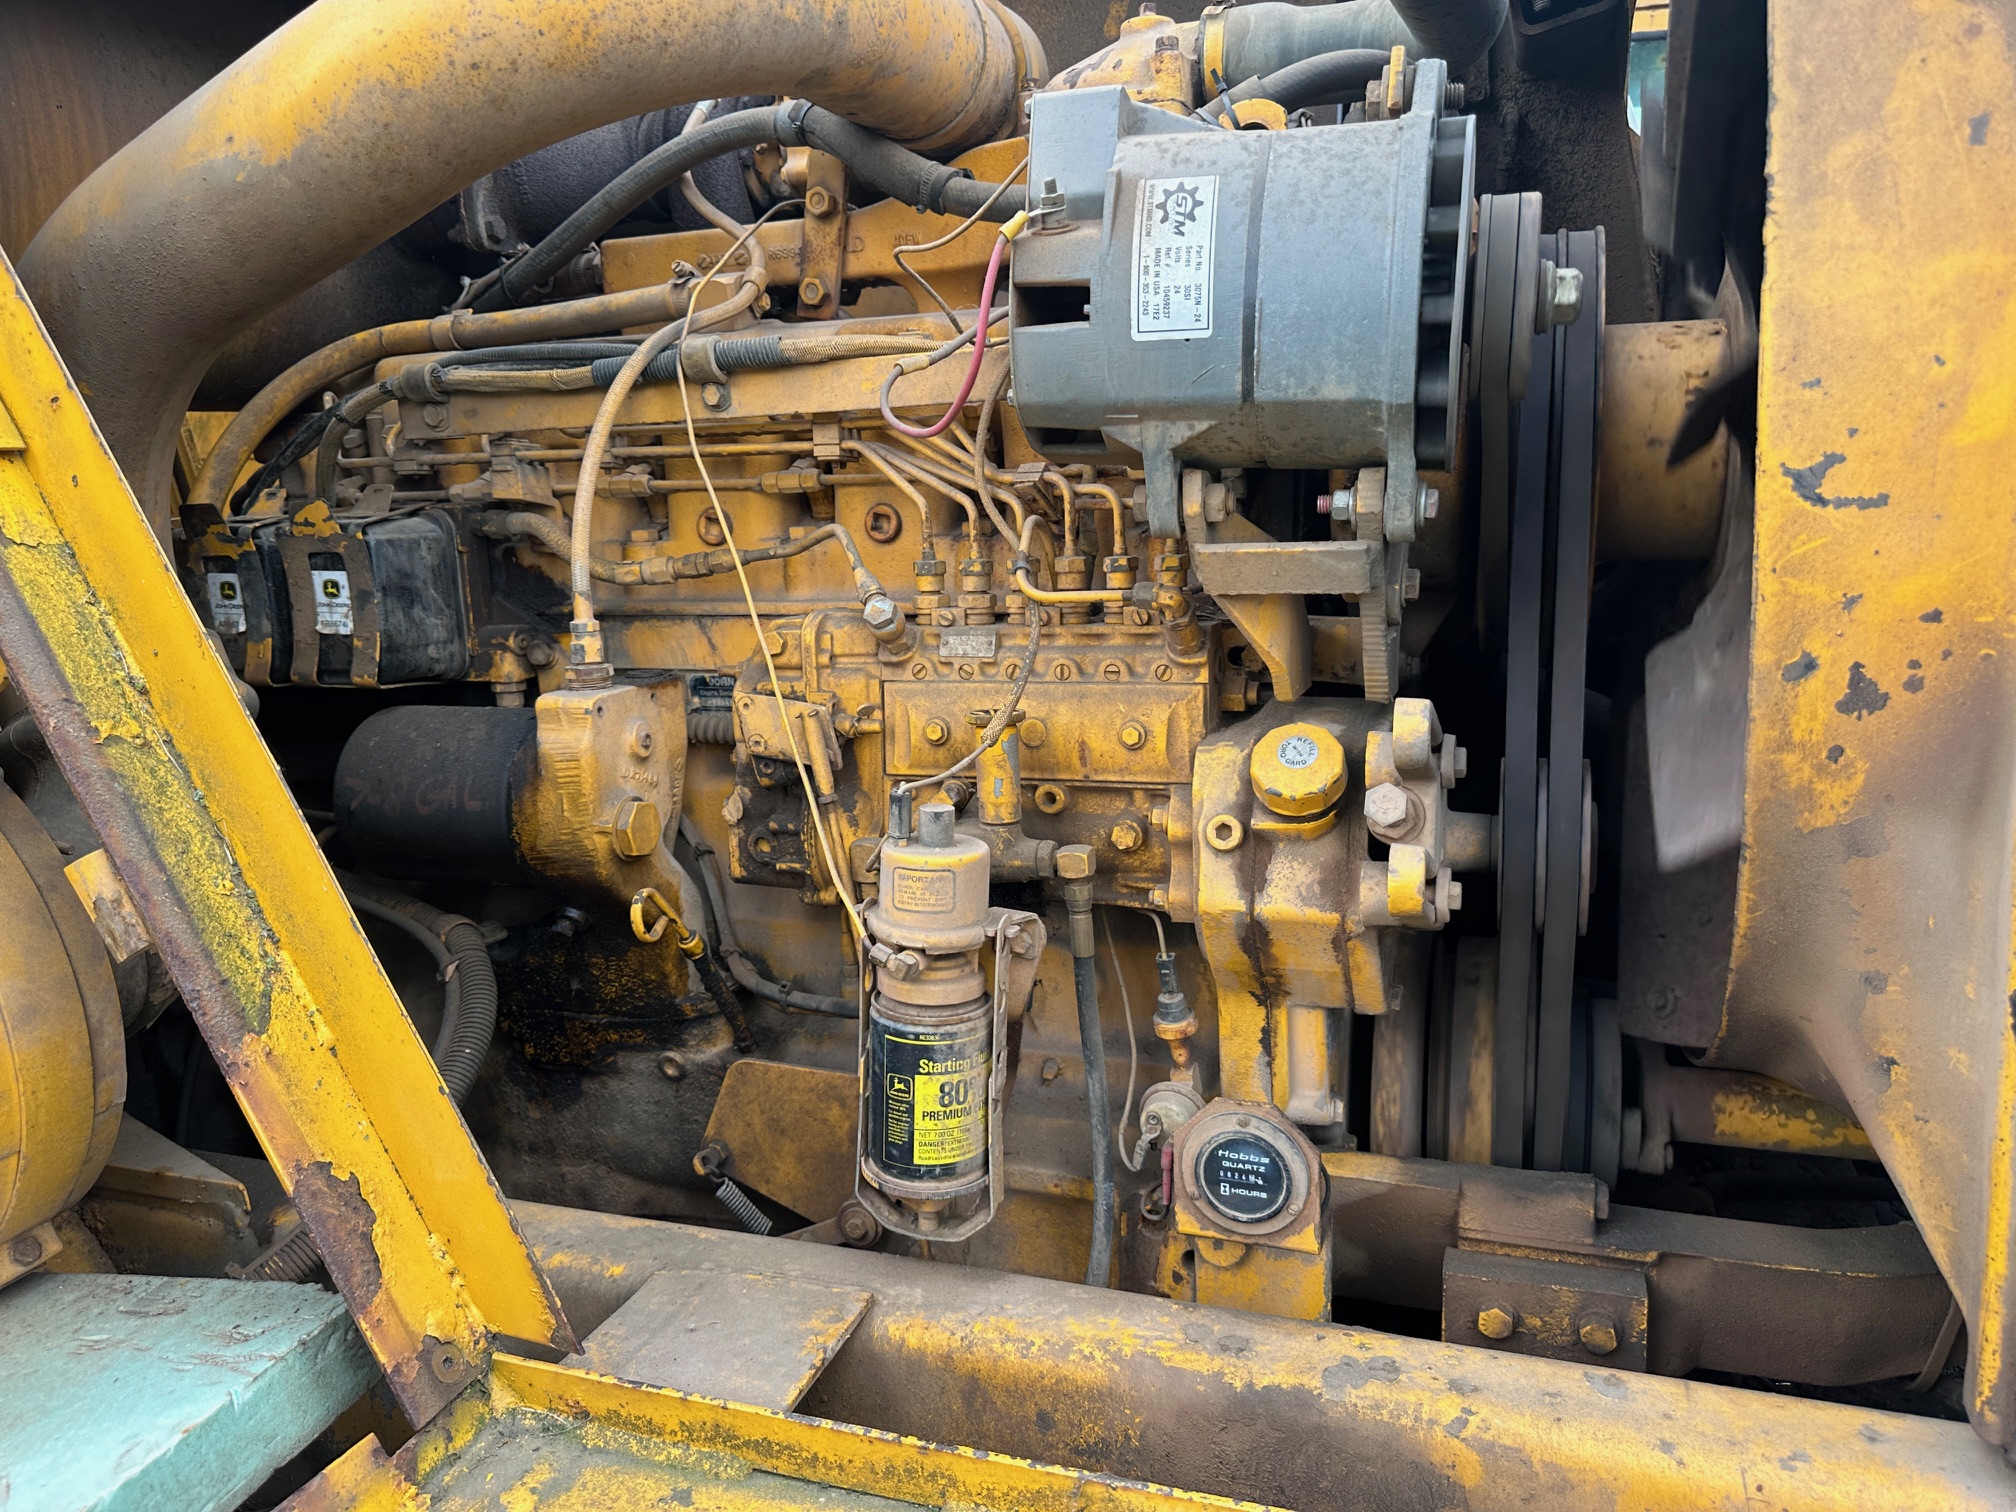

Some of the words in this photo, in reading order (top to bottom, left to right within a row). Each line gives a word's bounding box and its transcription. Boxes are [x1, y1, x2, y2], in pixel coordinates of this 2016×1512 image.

[1173, 194, 1188, 237] STM
[1174, 246, 1183, 263] Volts
[1184, 245, 1193, 268] Series
[1195, 245, 1203, 260] Part
[1153, 270, 1160, 278] IN
[1194, 262, 1202, 274] No.
[1174, 285, 1181, 295] 24
[1163, 285, 1171, 319] 10459237
[1292, 745, 1303, 756] WITH
[1297, 737, 1316, 756] REFILL
[919, 1058, 971, 1073] Starting
[922, 1106, 972, 1121] PREMIUM
[1218, 1149, 1270, 1163] Hobbs
[1222, 1161, 1265, 1172] QUARTZ
[1231, 1187, 1267, 1198] HOURS
